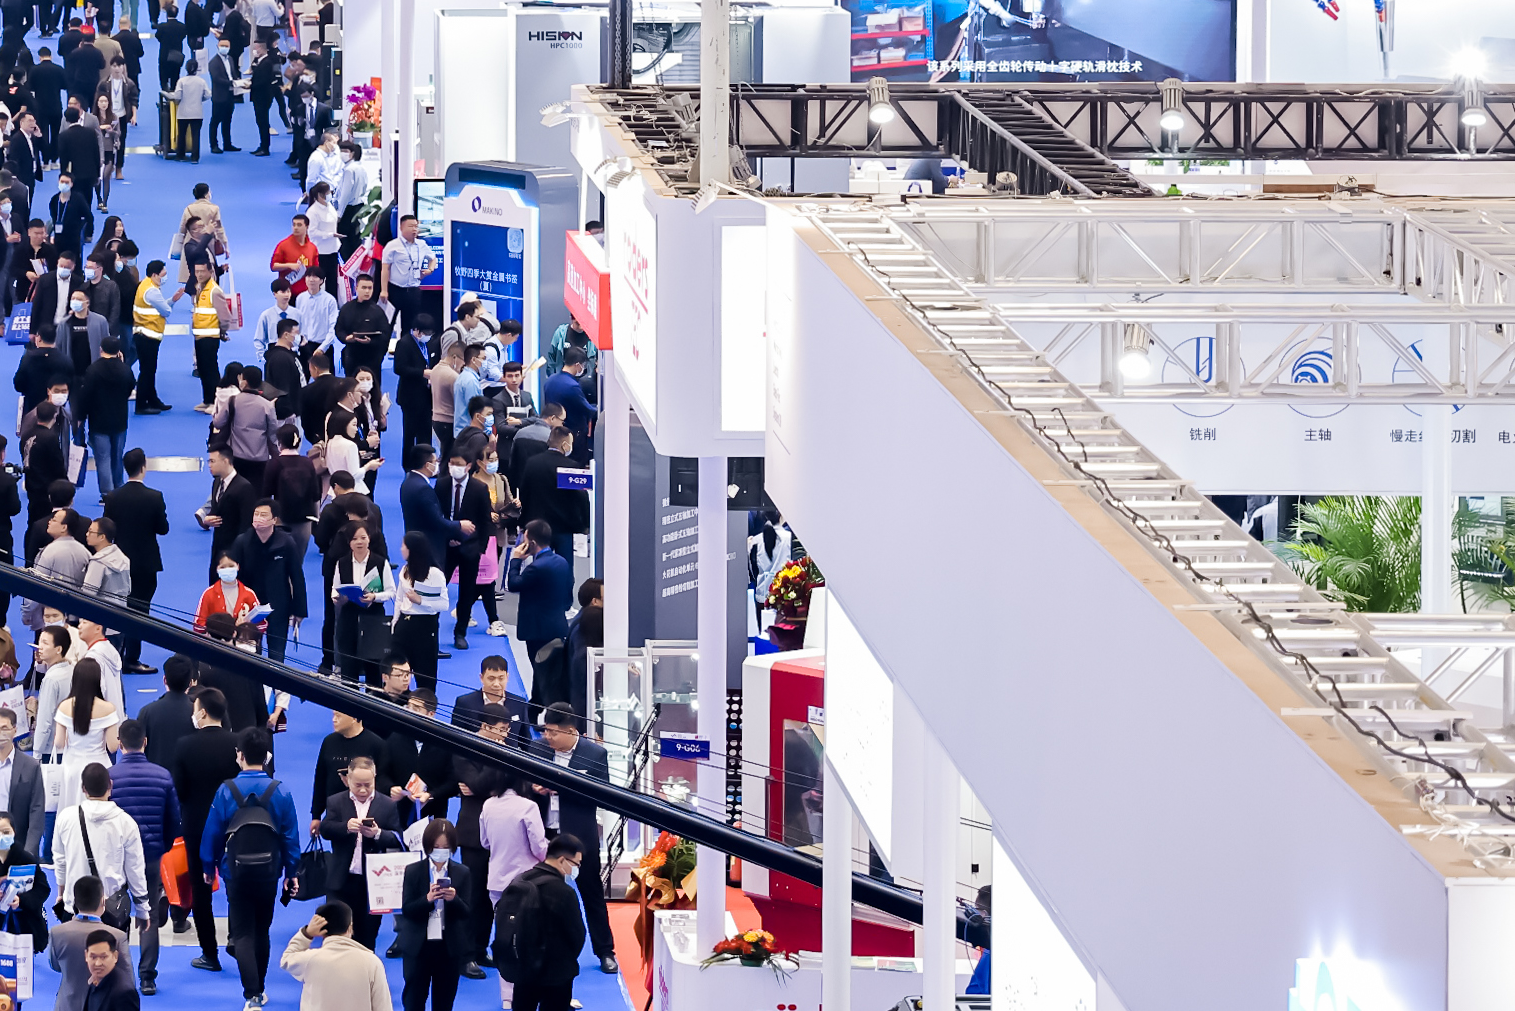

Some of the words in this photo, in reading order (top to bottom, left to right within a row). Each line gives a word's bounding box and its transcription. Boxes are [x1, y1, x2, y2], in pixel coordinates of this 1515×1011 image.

[1189, 428, 1216, 441] 铣削
[1304, 429, 1332, 442] 主轴
[0, 959, 13, 967] 1688
